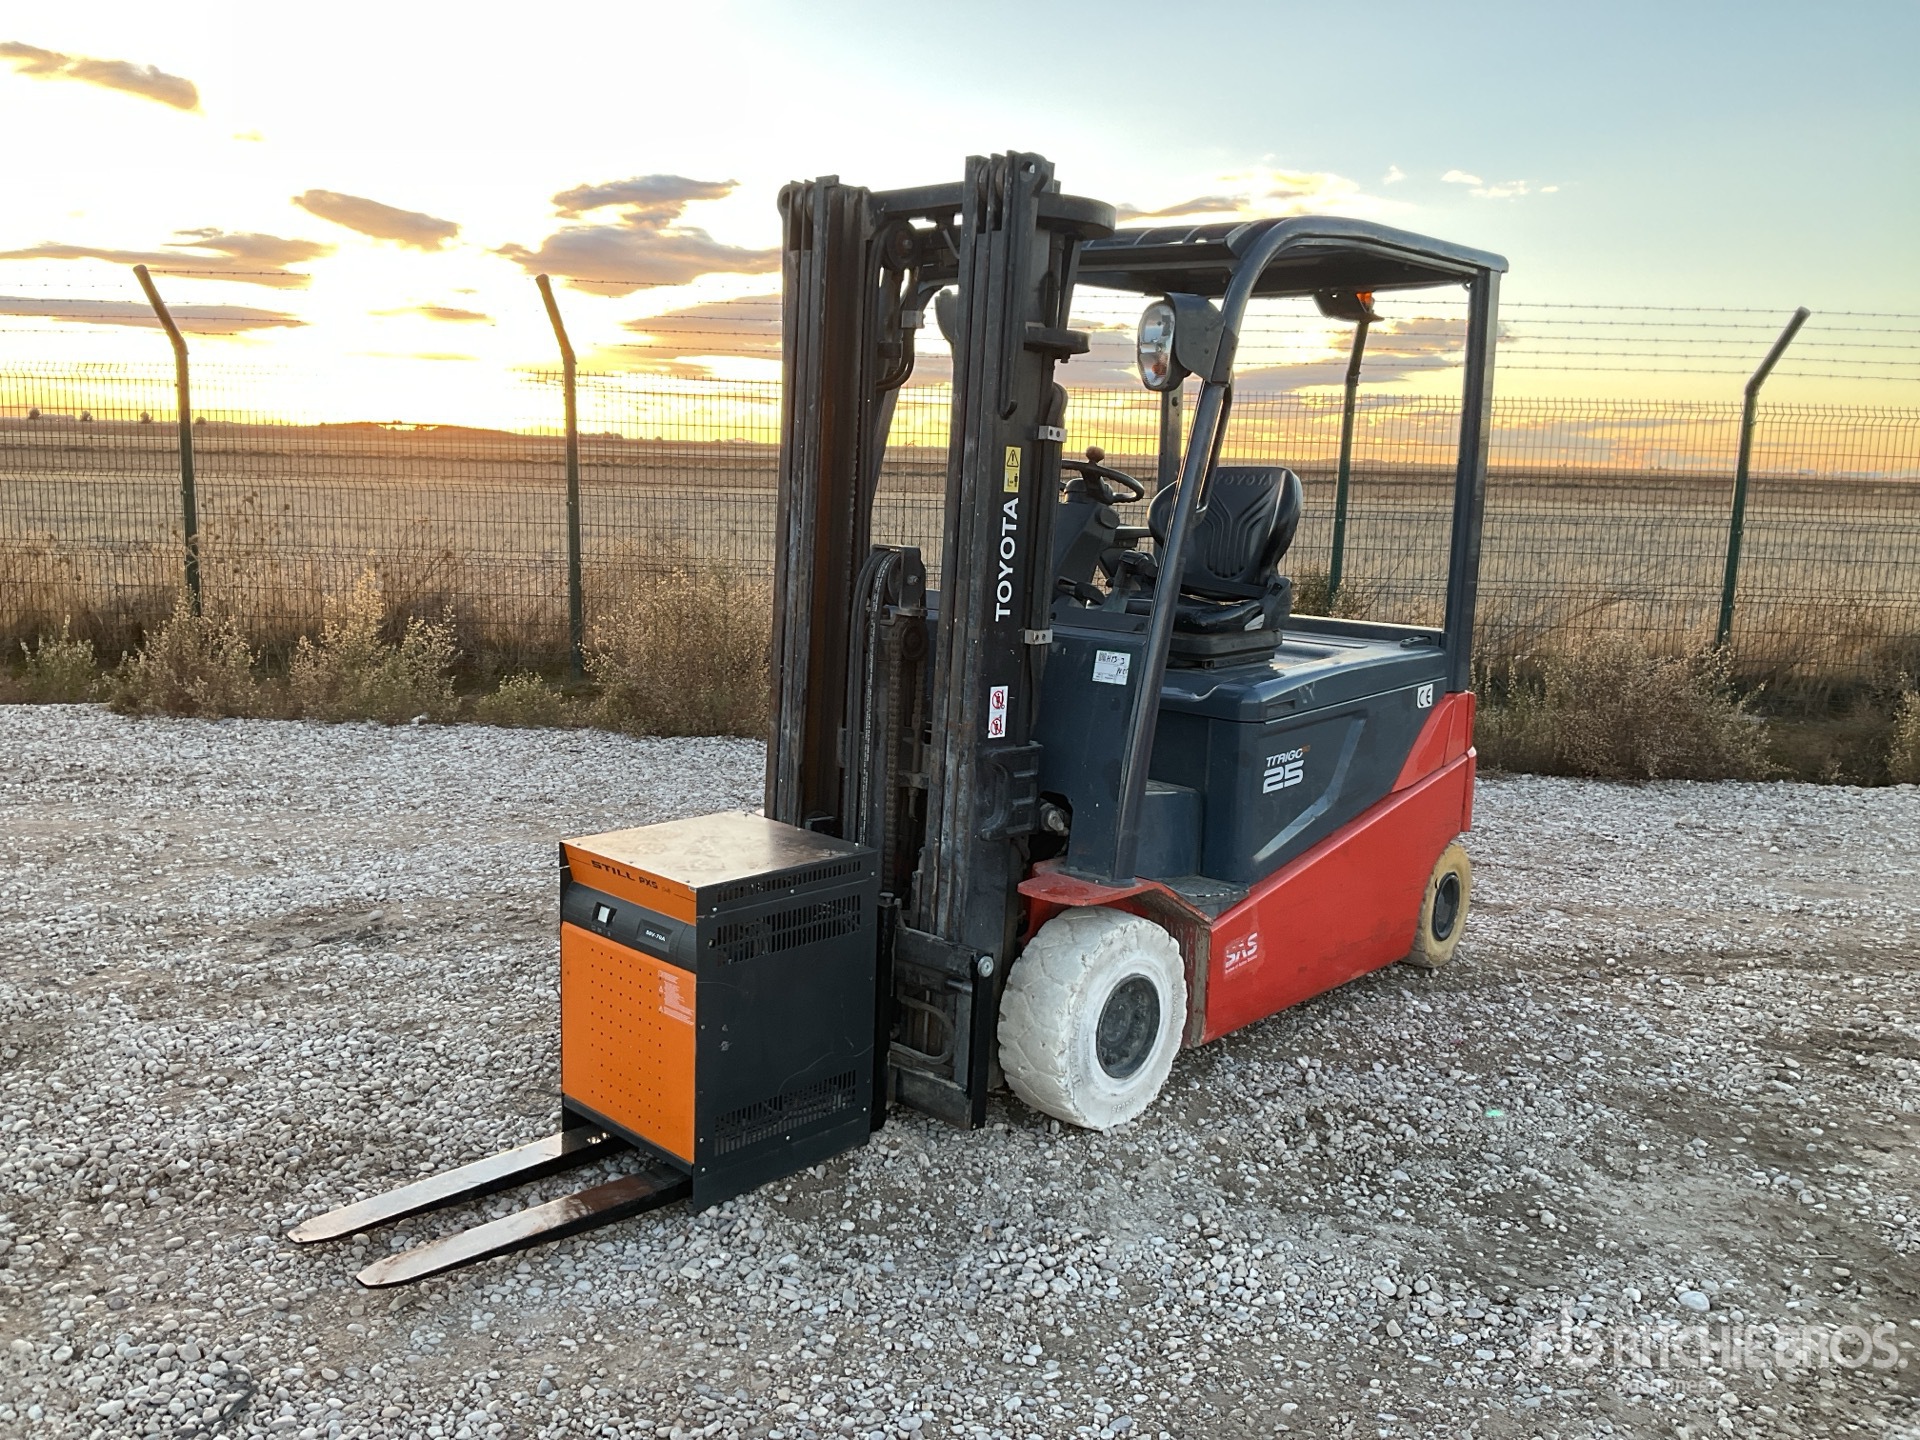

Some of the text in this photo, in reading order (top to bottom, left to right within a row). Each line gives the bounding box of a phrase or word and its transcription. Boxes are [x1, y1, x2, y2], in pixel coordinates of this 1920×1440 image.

[995, 497, 1020, 623] TOYOTA
[1262, 759, 1305, 794] 25
[590, 859, 636, 882] STILL
